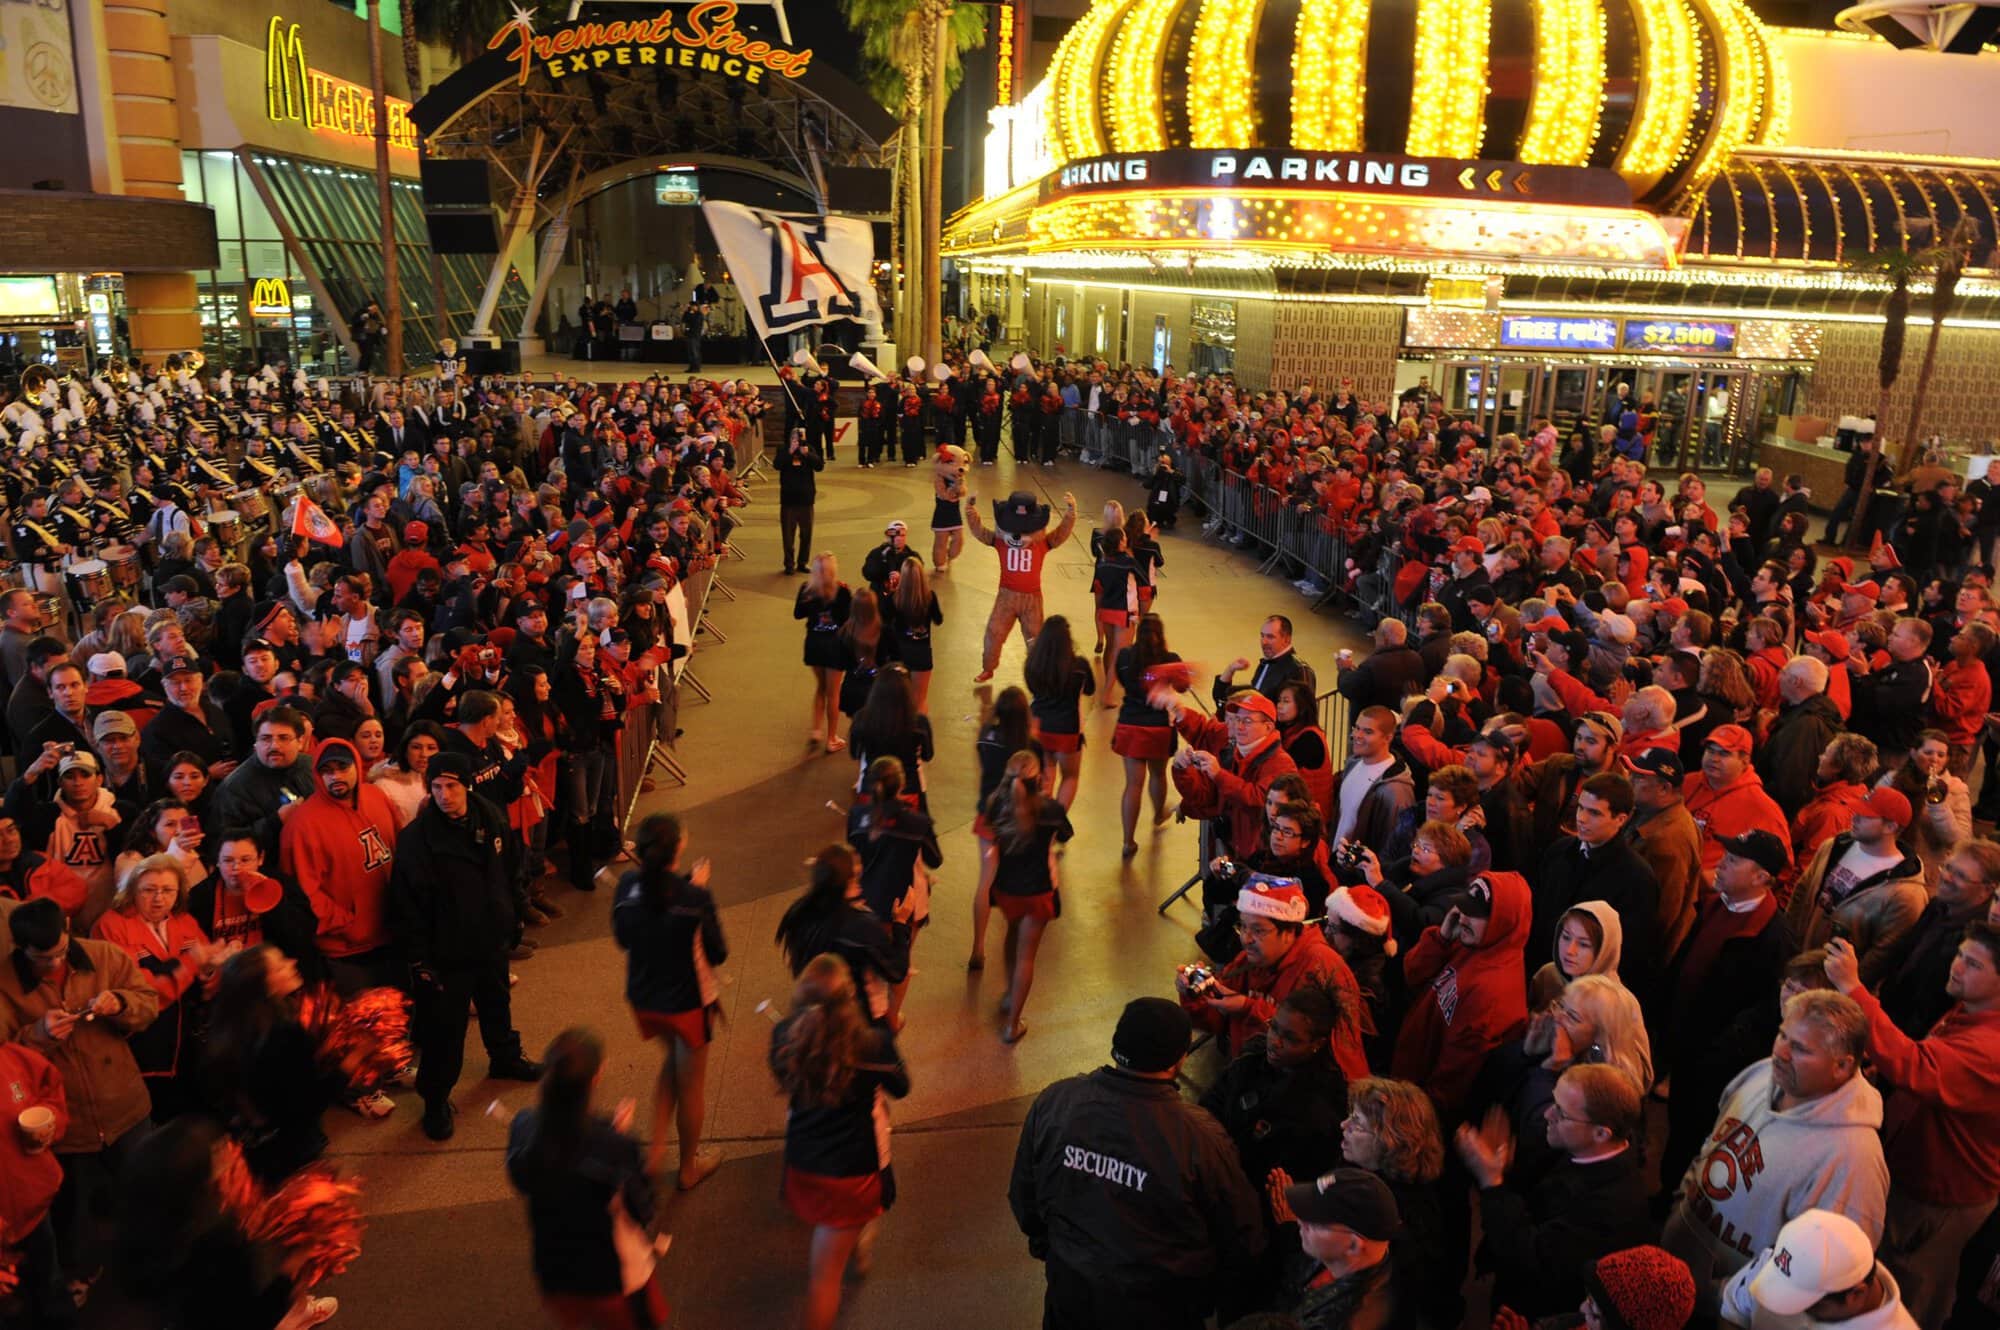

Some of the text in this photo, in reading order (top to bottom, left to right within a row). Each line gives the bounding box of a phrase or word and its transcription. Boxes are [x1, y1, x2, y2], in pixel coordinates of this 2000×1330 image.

[487, 0, 813, 86] Fremont Street
[547, 47, 765, 84] EXPERIENCE
[1060, 159, 1147, 187] ARKING
[1211, 156, 1430, 187] PARKING
[1509, 320, 1557, 340] FREE
[1643, 324, 1716, 345] $2,500
[1007, 547, 1032, 572] 08
[65, 832, 104, 866] A
[358, 824, 392, 872] A
[1063, 1144, 1148, 1192] SECURITY
[1774, 1247, 1793, 1278] A
